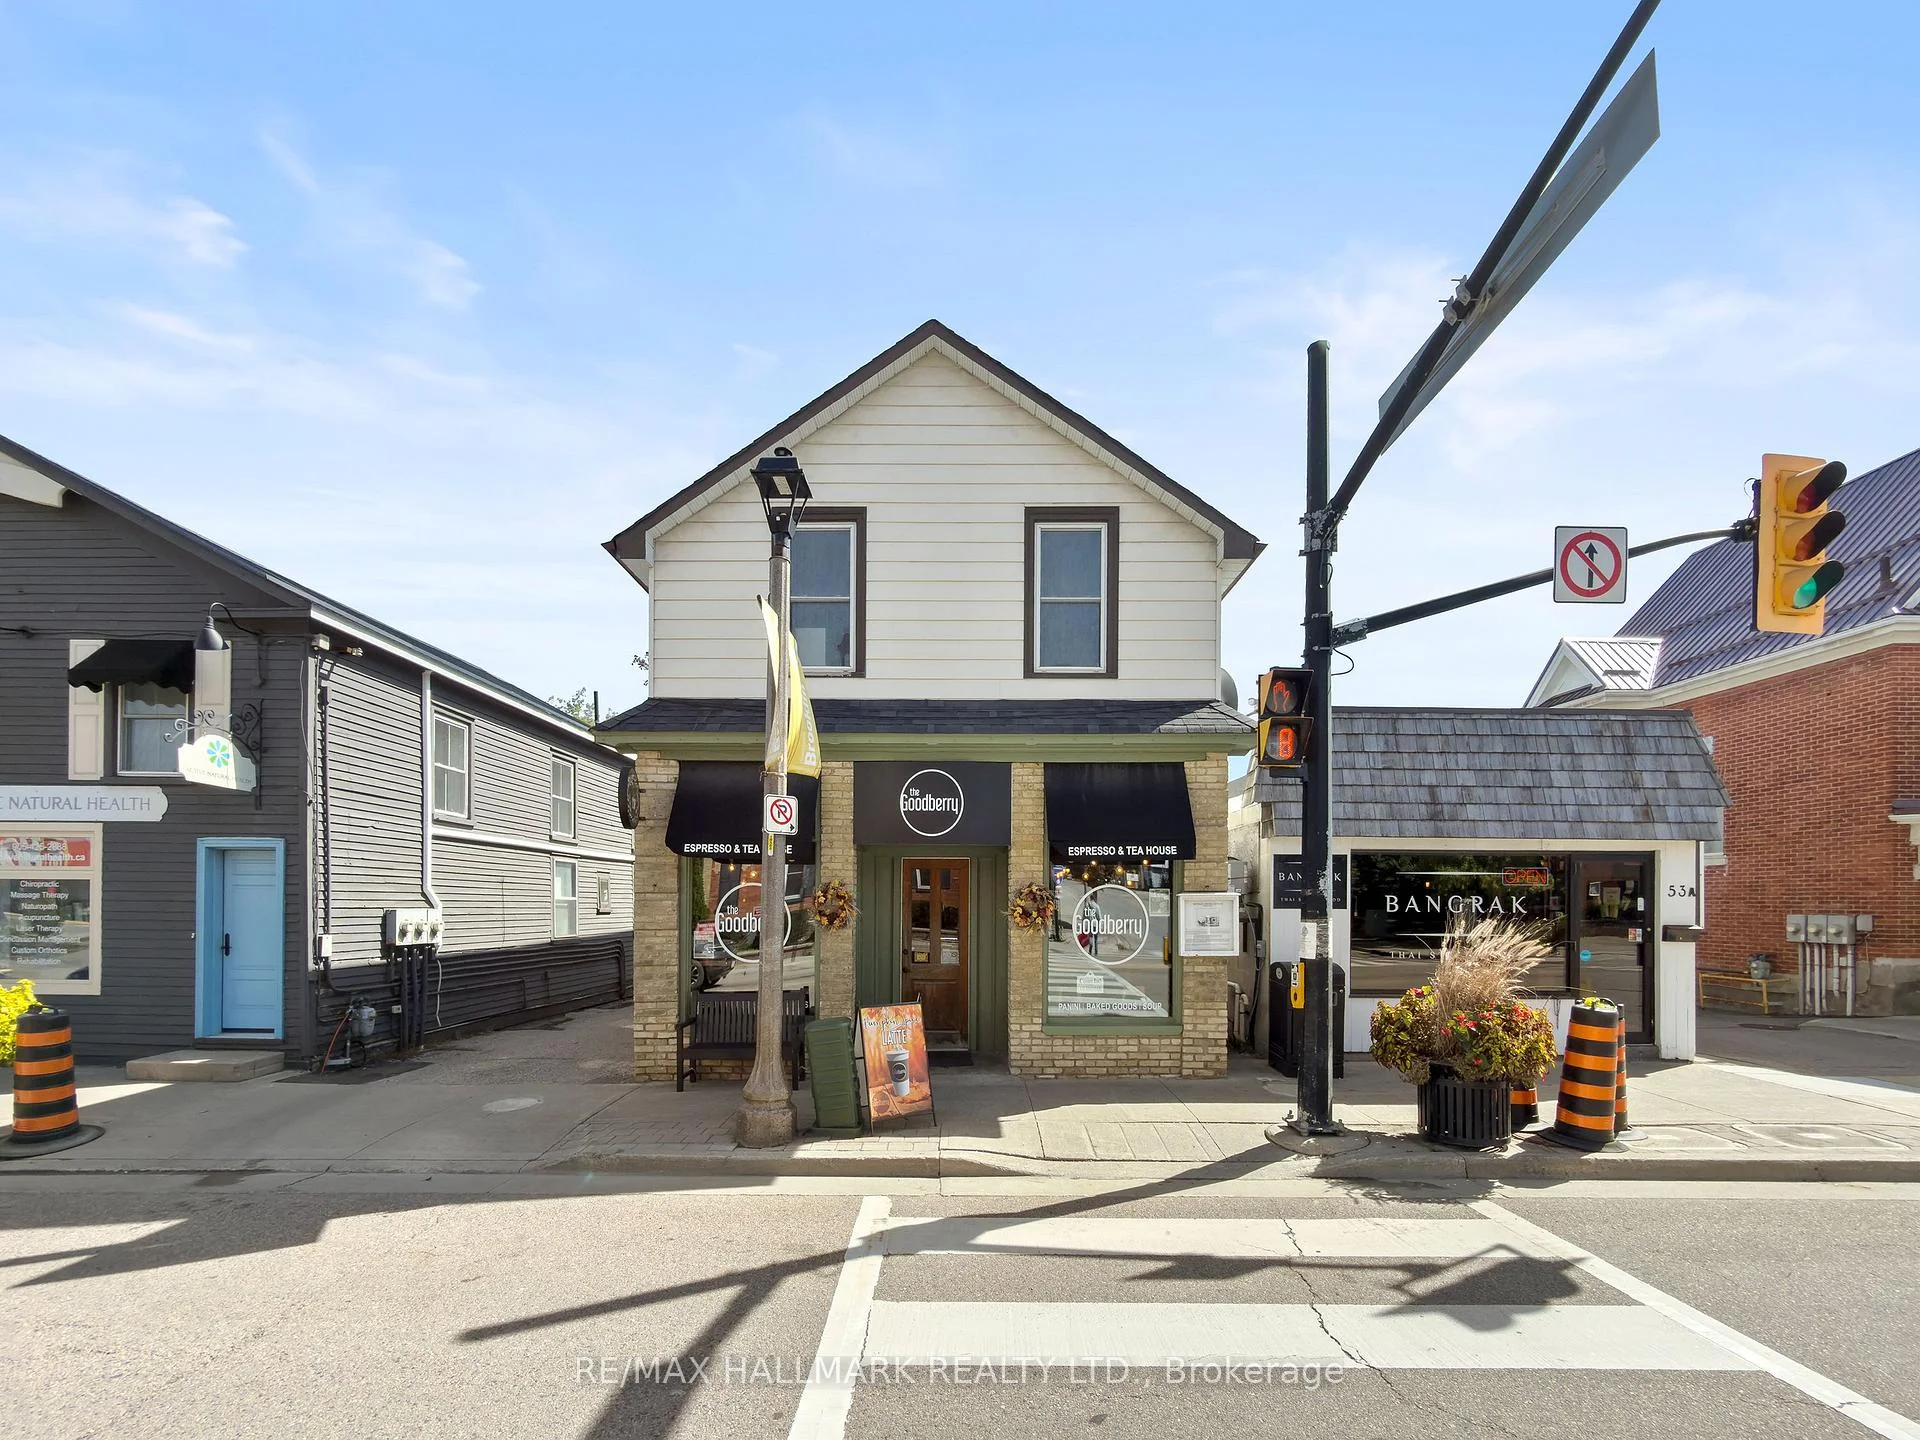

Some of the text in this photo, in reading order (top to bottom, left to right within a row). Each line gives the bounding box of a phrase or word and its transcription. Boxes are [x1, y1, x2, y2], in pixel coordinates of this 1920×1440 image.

[909, 787, 920, 797] the
[8, 796, 82, 810] NATURAL
[87, 797, 150, 811] HEALTH
[900, 793, 959, 815] Goodberry
[683, 843, 761, 854] ESPRESSO & TEA
[1068, 845, 1178, 856] ESPRESSO & TEA HOUSE
[1504, 869, 1547, 884] OPEN
[20, 880, 60, 888] Chiropractic
[10, 891, 69, 900] Massage Therapy
[1667, 884, 1697, 898] 53A
[21, 902, 58, 911] Naturopath
[1384, 894, 1528, 914] BANGRAK
[726, 905, 739, 915] the
[1084, 906, 1096, 917] the
[717, 912, 761, 933] Goodb
[1074, 914, 1142, 938] Goodberry
[36, 924, 63, 933] Therapy
[11, 946, 68, 954] Custom Orthotics
[1389, 951, 1421, 959] THAI
[1058, 1002, 1162, 1011] PANINI BAKED GOODS SOUP
[881, 1029, 907, 1046] LATTE
